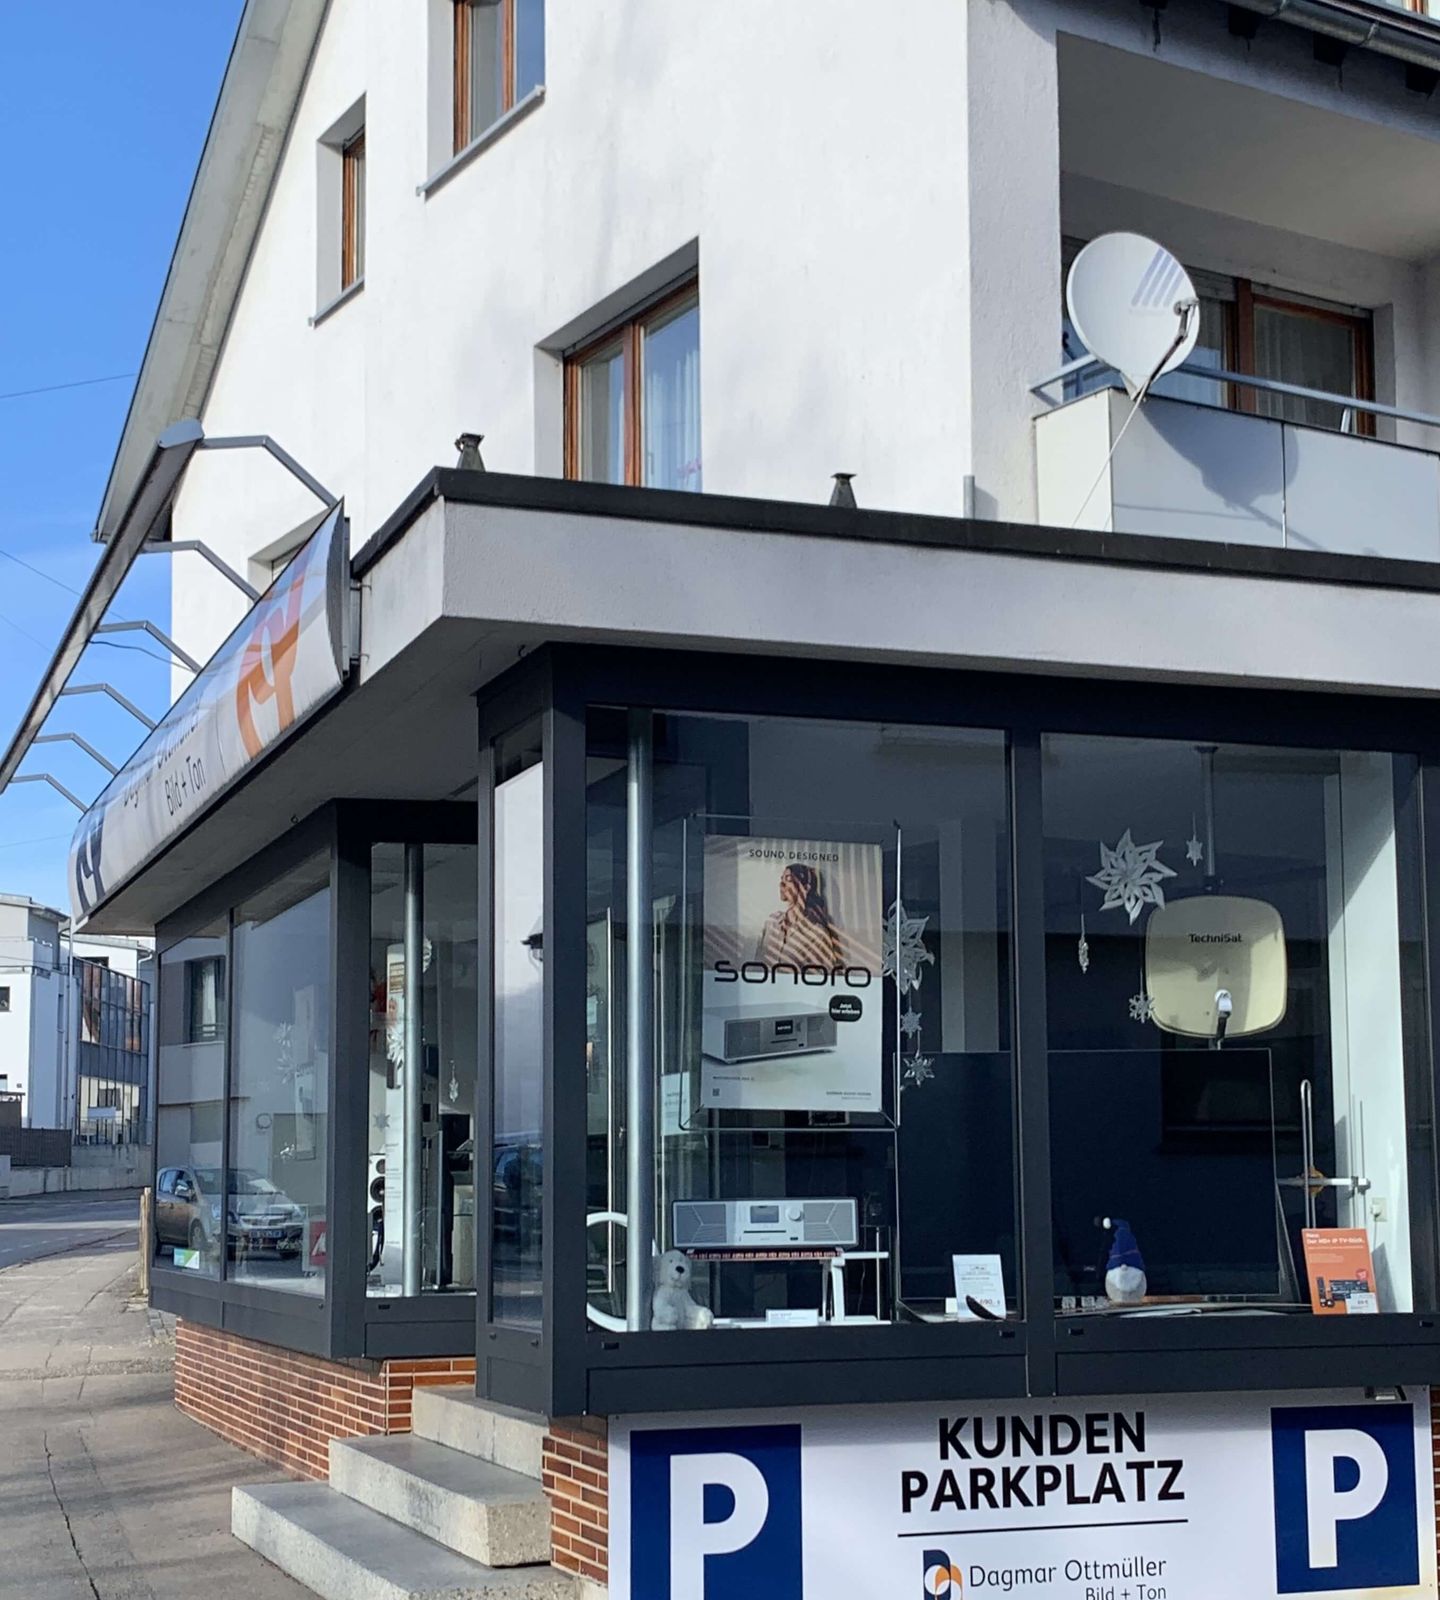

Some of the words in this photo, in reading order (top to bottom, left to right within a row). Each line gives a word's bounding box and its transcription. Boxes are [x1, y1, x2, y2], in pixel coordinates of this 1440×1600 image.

[164, 769, 183, 816] Bild
[181, 771, 188, 798] +
[186, 755, 206, 794] Ton
[749, 848, 785, 859] SOUND
[788, 851, 839, 862] DESIGNED
[1189, 932, 1243, 943] TechniSat
[714, 960, 872, 988] sonoro
[938, 1411, 1146, 1461] KUNDEN
[901, 1459, 1185, 1514] PARKPLATZ
[1304, 1428, 1389, 1569] P
[670, 1452, 769, 1600] P
[969, 1565, 1058, 1592] Dagmar
[1064, 1556, 1168, 1582] Ottmüller
[1085, 1586, 1114, 1600] Bild
[1136, 1584, 1167, 1600] Ton
